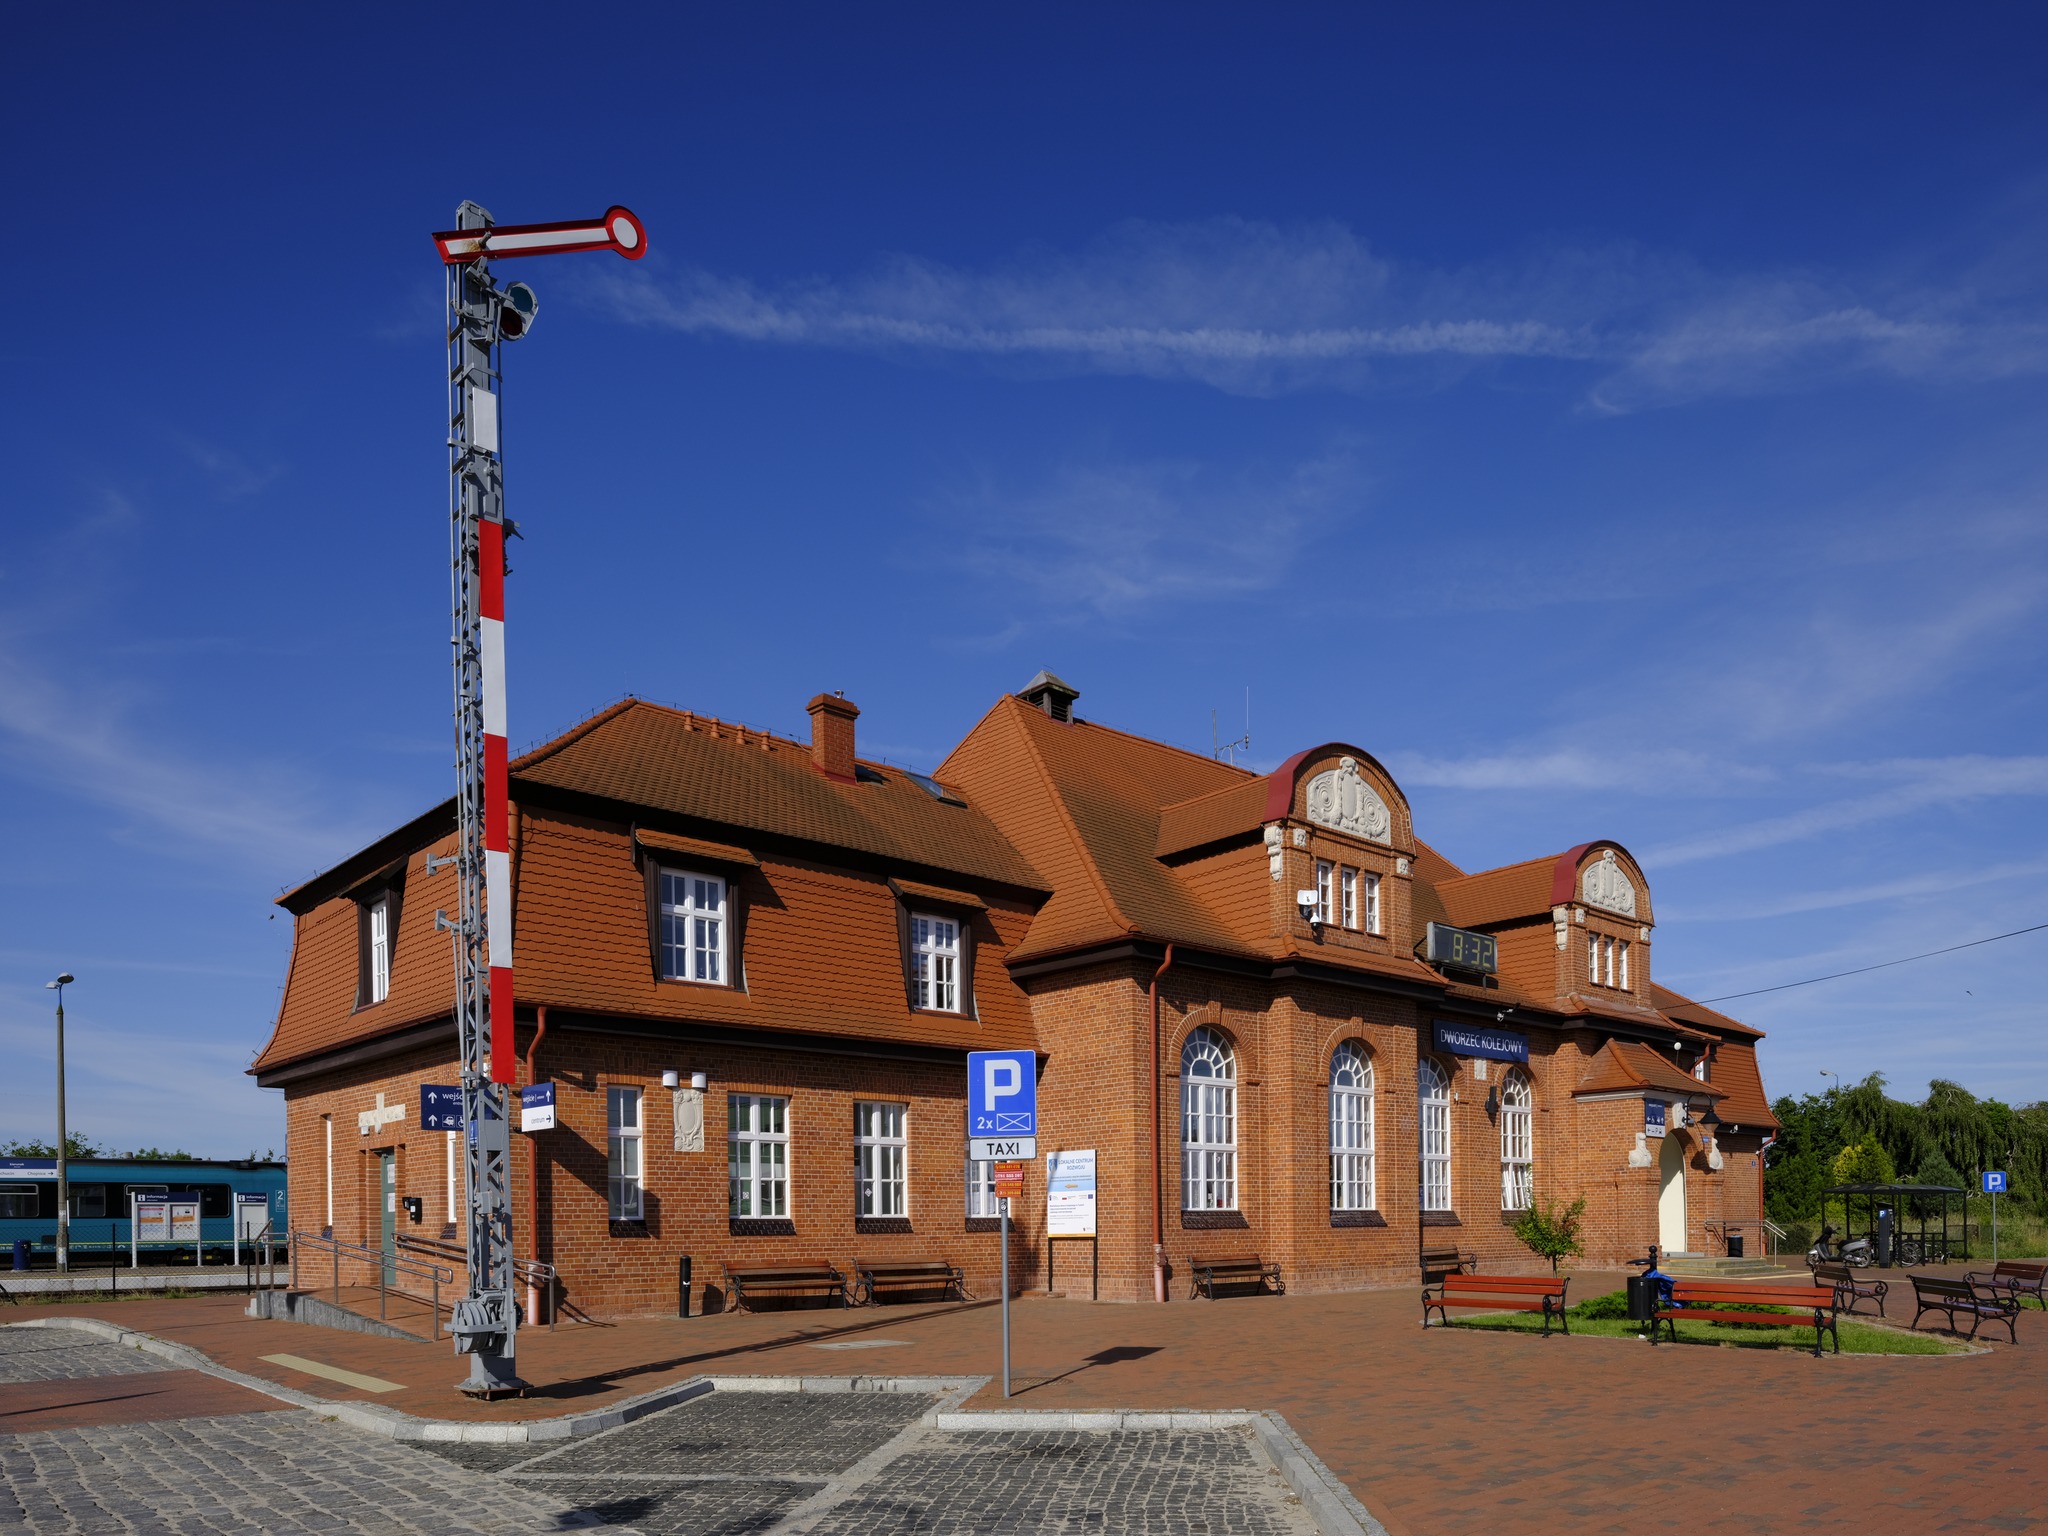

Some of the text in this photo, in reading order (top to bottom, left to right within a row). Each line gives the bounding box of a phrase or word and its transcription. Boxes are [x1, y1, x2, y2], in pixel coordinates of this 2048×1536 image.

[1453, 934, 1492, 968] 8:32
[1440, 1029, 1523, 1054] DWORZEC KOLEJOWY
[984, 1059, 1021, 1111] P
[977, 1116, 993, 1129] 2x
[986, 1142, 1020, 1156] TAXI
[1988, 1174, 2001, 1189] P
[277, 1190, 284, 1200] 2
